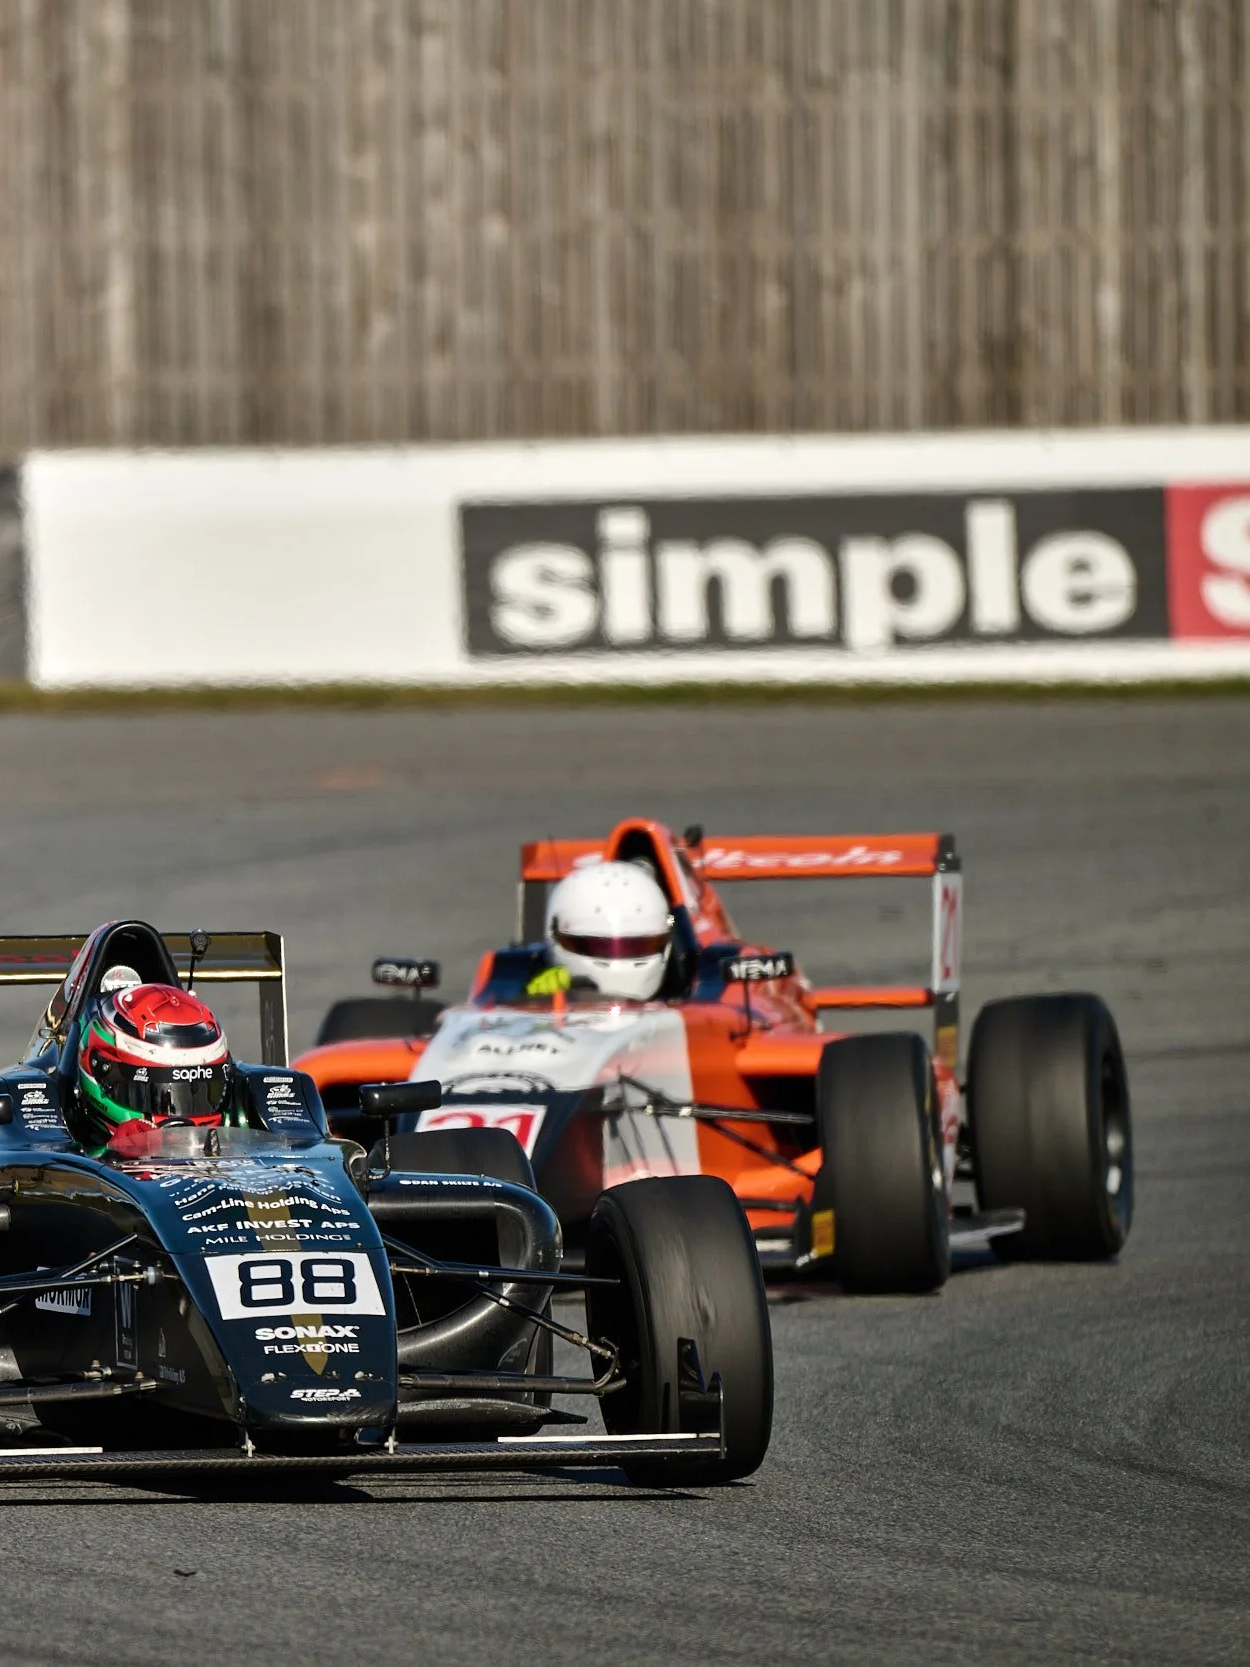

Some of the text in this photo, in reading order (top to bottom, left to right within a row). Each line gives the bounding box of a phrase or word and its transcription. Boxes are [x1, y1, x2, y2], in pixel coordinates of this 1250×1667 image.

[491, 498, 1137, 653] simple
[172, 1065, 213, 1083] saphe
[258, 1196, 319, 1210] Holding
[187, 1219, 360, 1234] AKF INVEST APS
[205, 1235, 248, 1245] MILE
[238, 1259, 357, 1308] 88
[255, 1325, 359, 1341] SONAX
